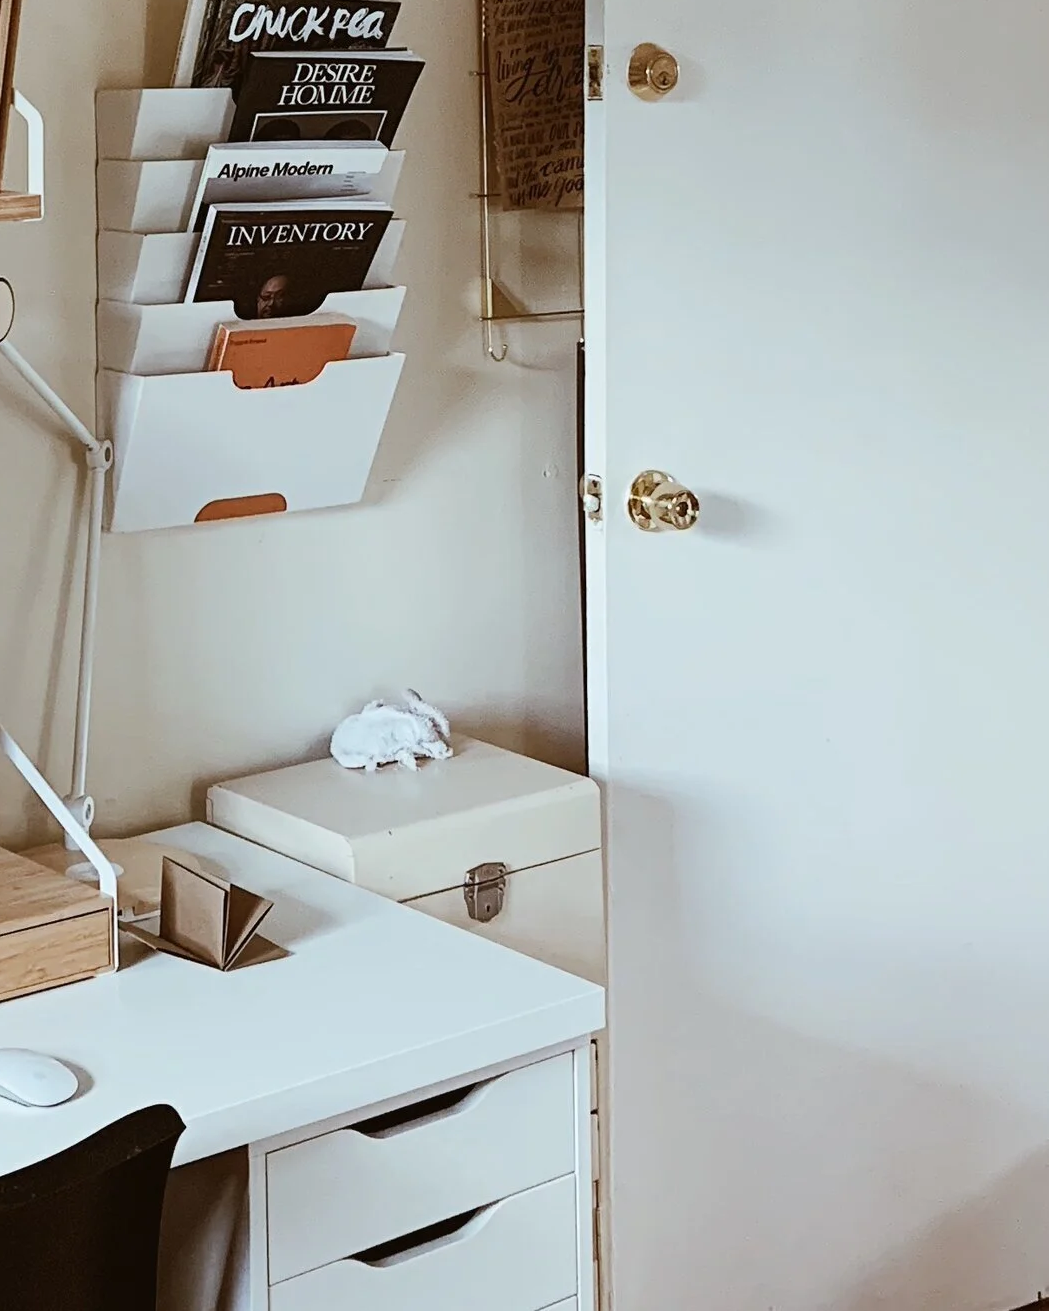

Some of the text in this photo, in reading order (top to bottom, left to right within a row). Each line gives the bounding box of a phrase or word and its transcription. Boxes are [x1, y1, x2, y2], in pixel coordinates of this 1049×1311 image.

[291, 63, 377, 83] DESIRE
[277, 84, 376, 106] HOMME
[217, 161, 334, 181] Alpine Modern
[226, 222, 374, 246] INVENTORY
